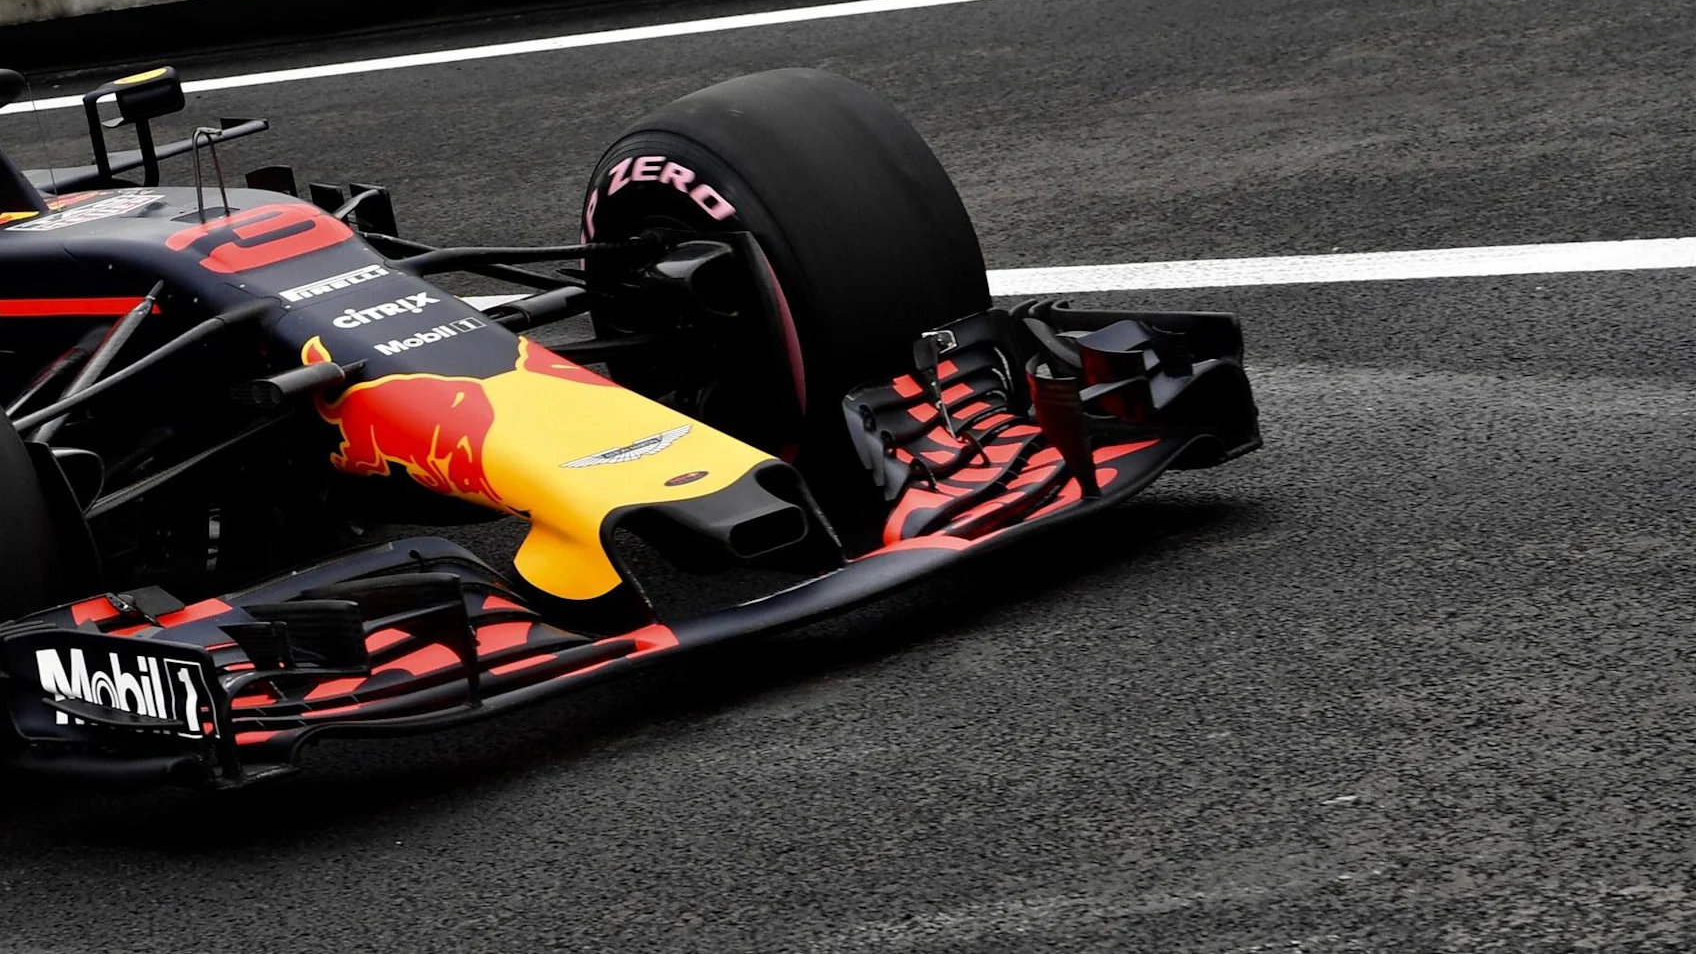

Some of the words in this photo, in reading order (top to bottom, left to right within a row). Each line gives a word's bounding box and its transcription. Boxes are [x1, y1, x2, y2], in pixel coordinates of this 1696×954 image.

[608, 156, 737, 221] ZERO
[165, 203, 354, 273] 3
[279, 264, 390, 302] PIRELLI
[374, 324, 458, 356] Mobil
[35, 648, 170, 734] Mobil
[176, 667, 201, 732] 1
